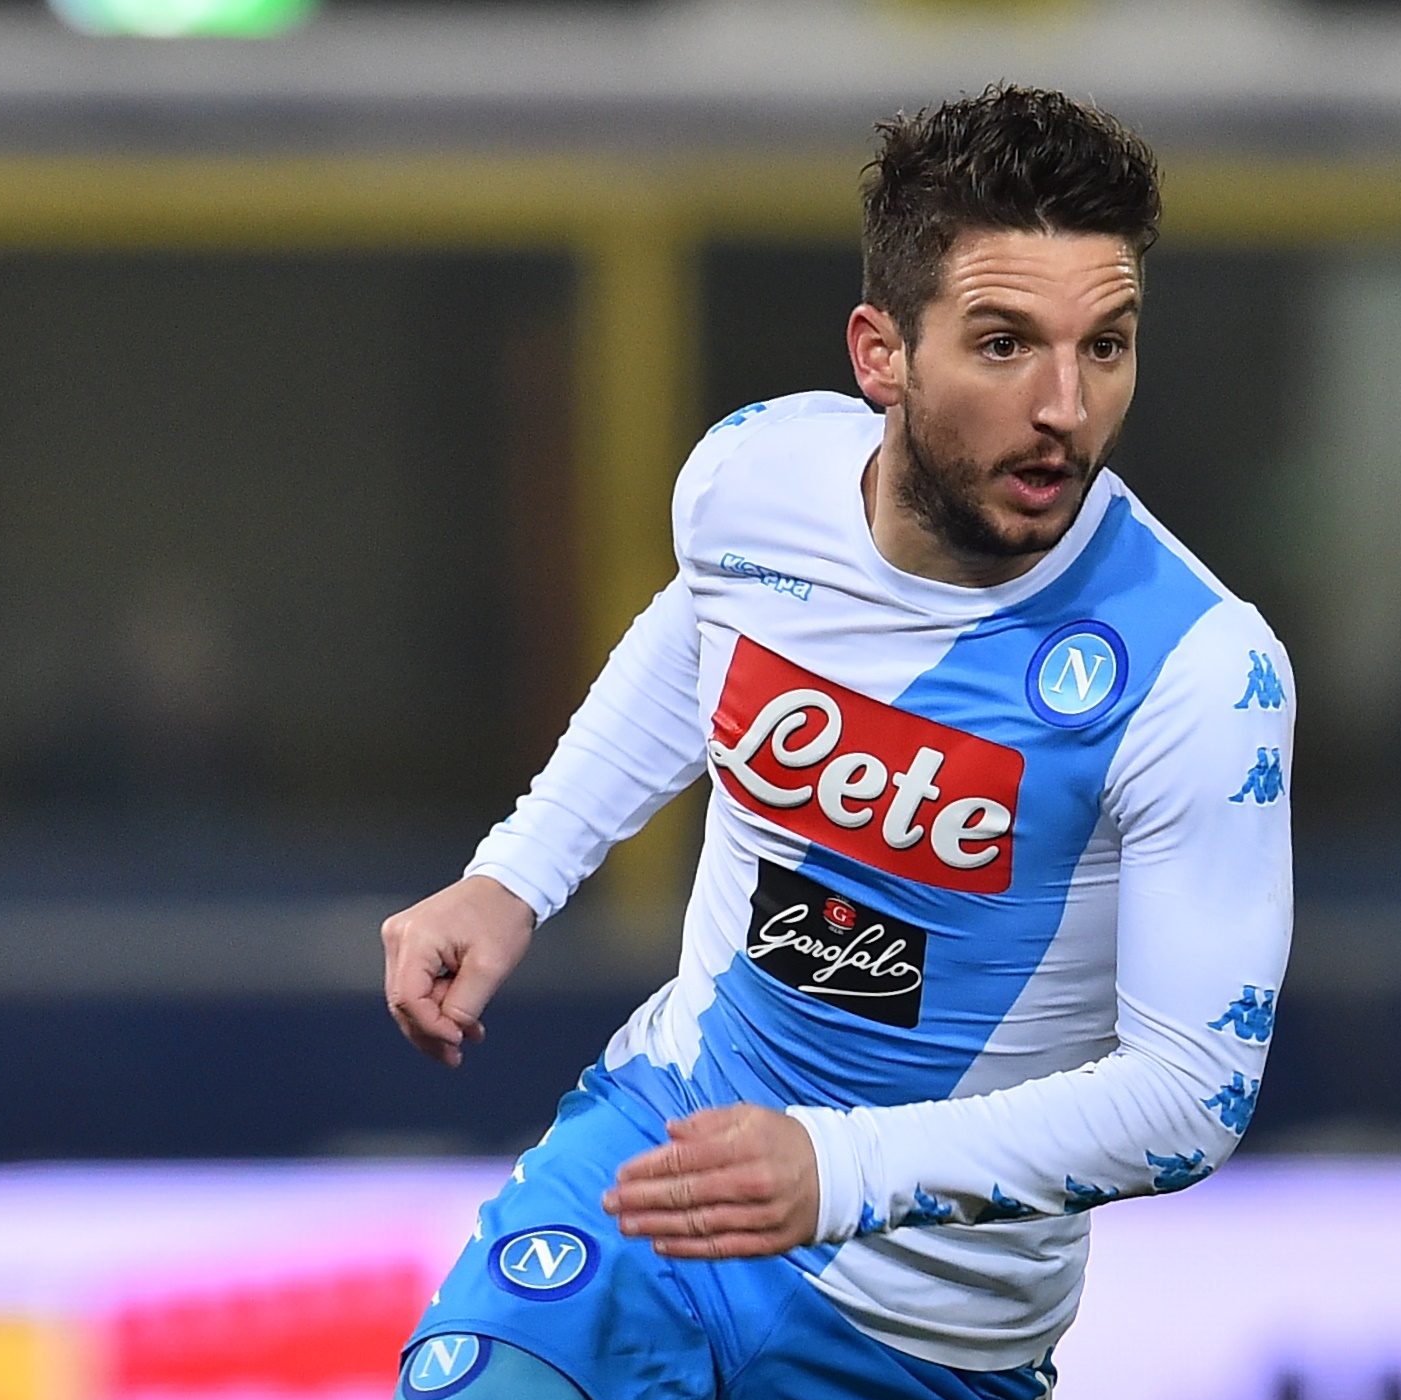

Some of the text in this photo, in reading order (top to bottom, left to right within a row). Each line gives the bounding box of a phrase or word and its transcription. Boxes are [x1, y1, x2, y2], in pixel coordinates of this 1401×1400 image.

[1049, 646, 1107, 701] N
[708, 688, 1011, 869] Lete
[748, 903, 923, 997] Garofalo
[510, 1237, 576, 1279] N
[416, 1337, 469, 1377] N
